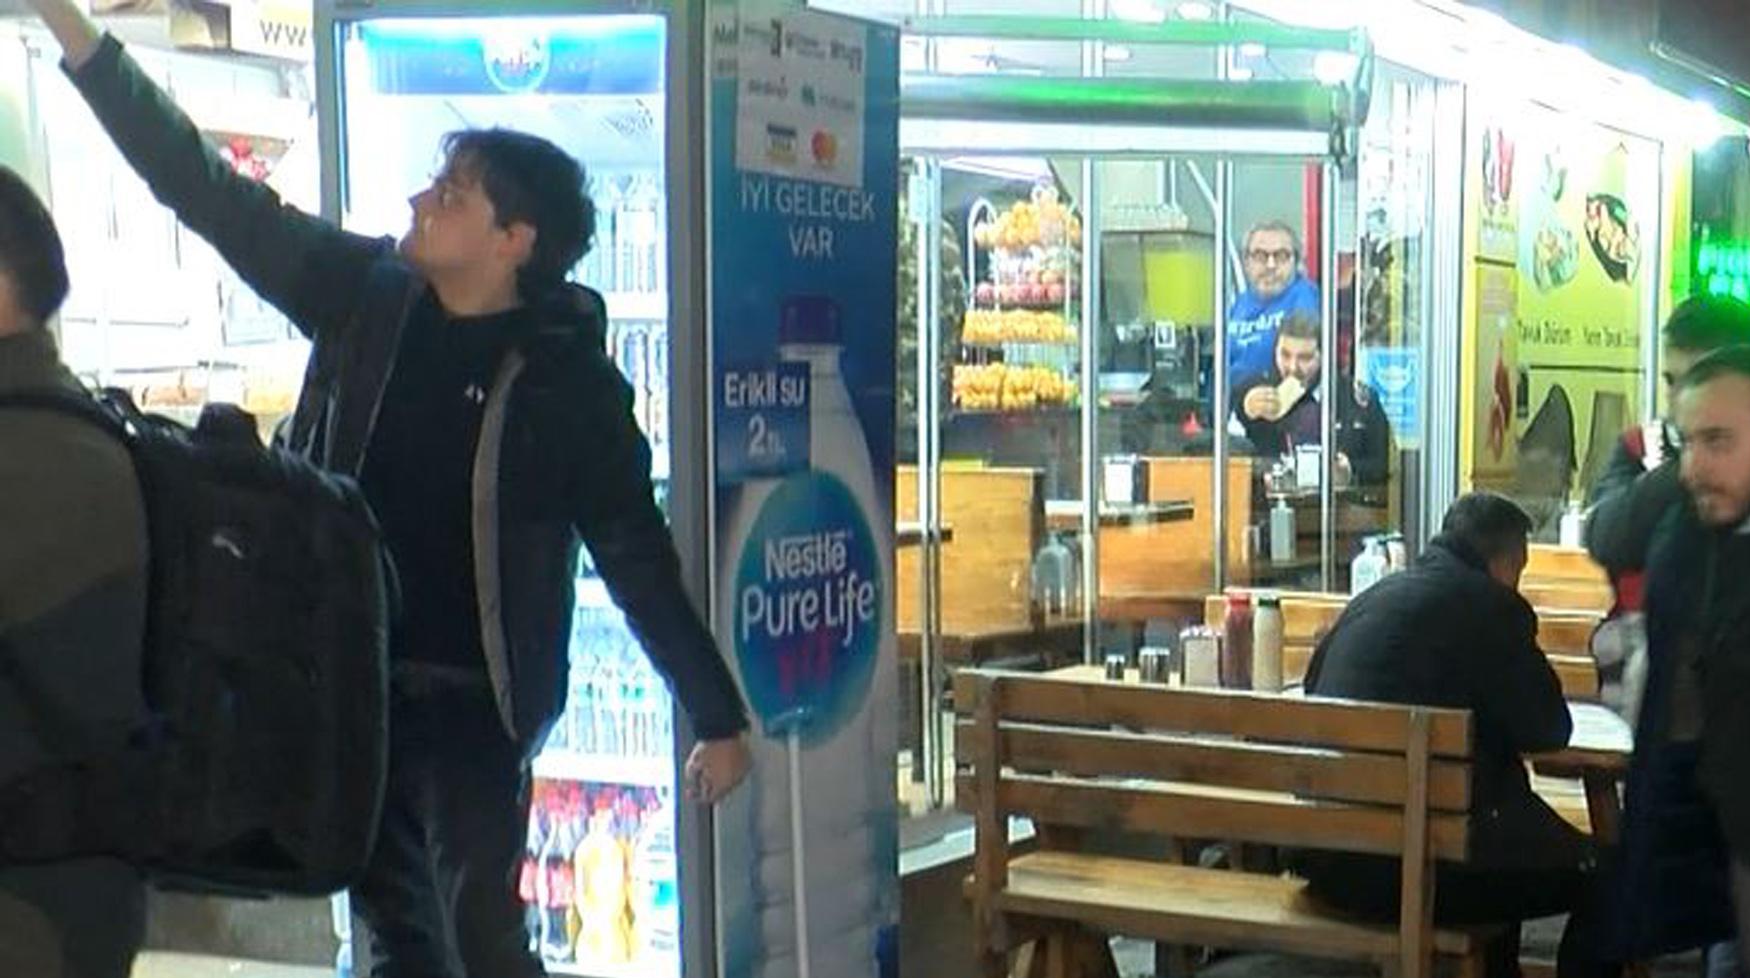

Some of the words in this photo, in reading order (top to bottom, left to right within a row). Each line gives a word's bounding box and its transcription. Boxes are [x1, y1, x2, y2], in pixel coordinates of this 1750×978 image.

[775, 181, 876, 222] GELECEK
[788, 225, 835, 259] VAR
[742, 584, 820, 643] Pure
[824, 570, 875, 647] Life
